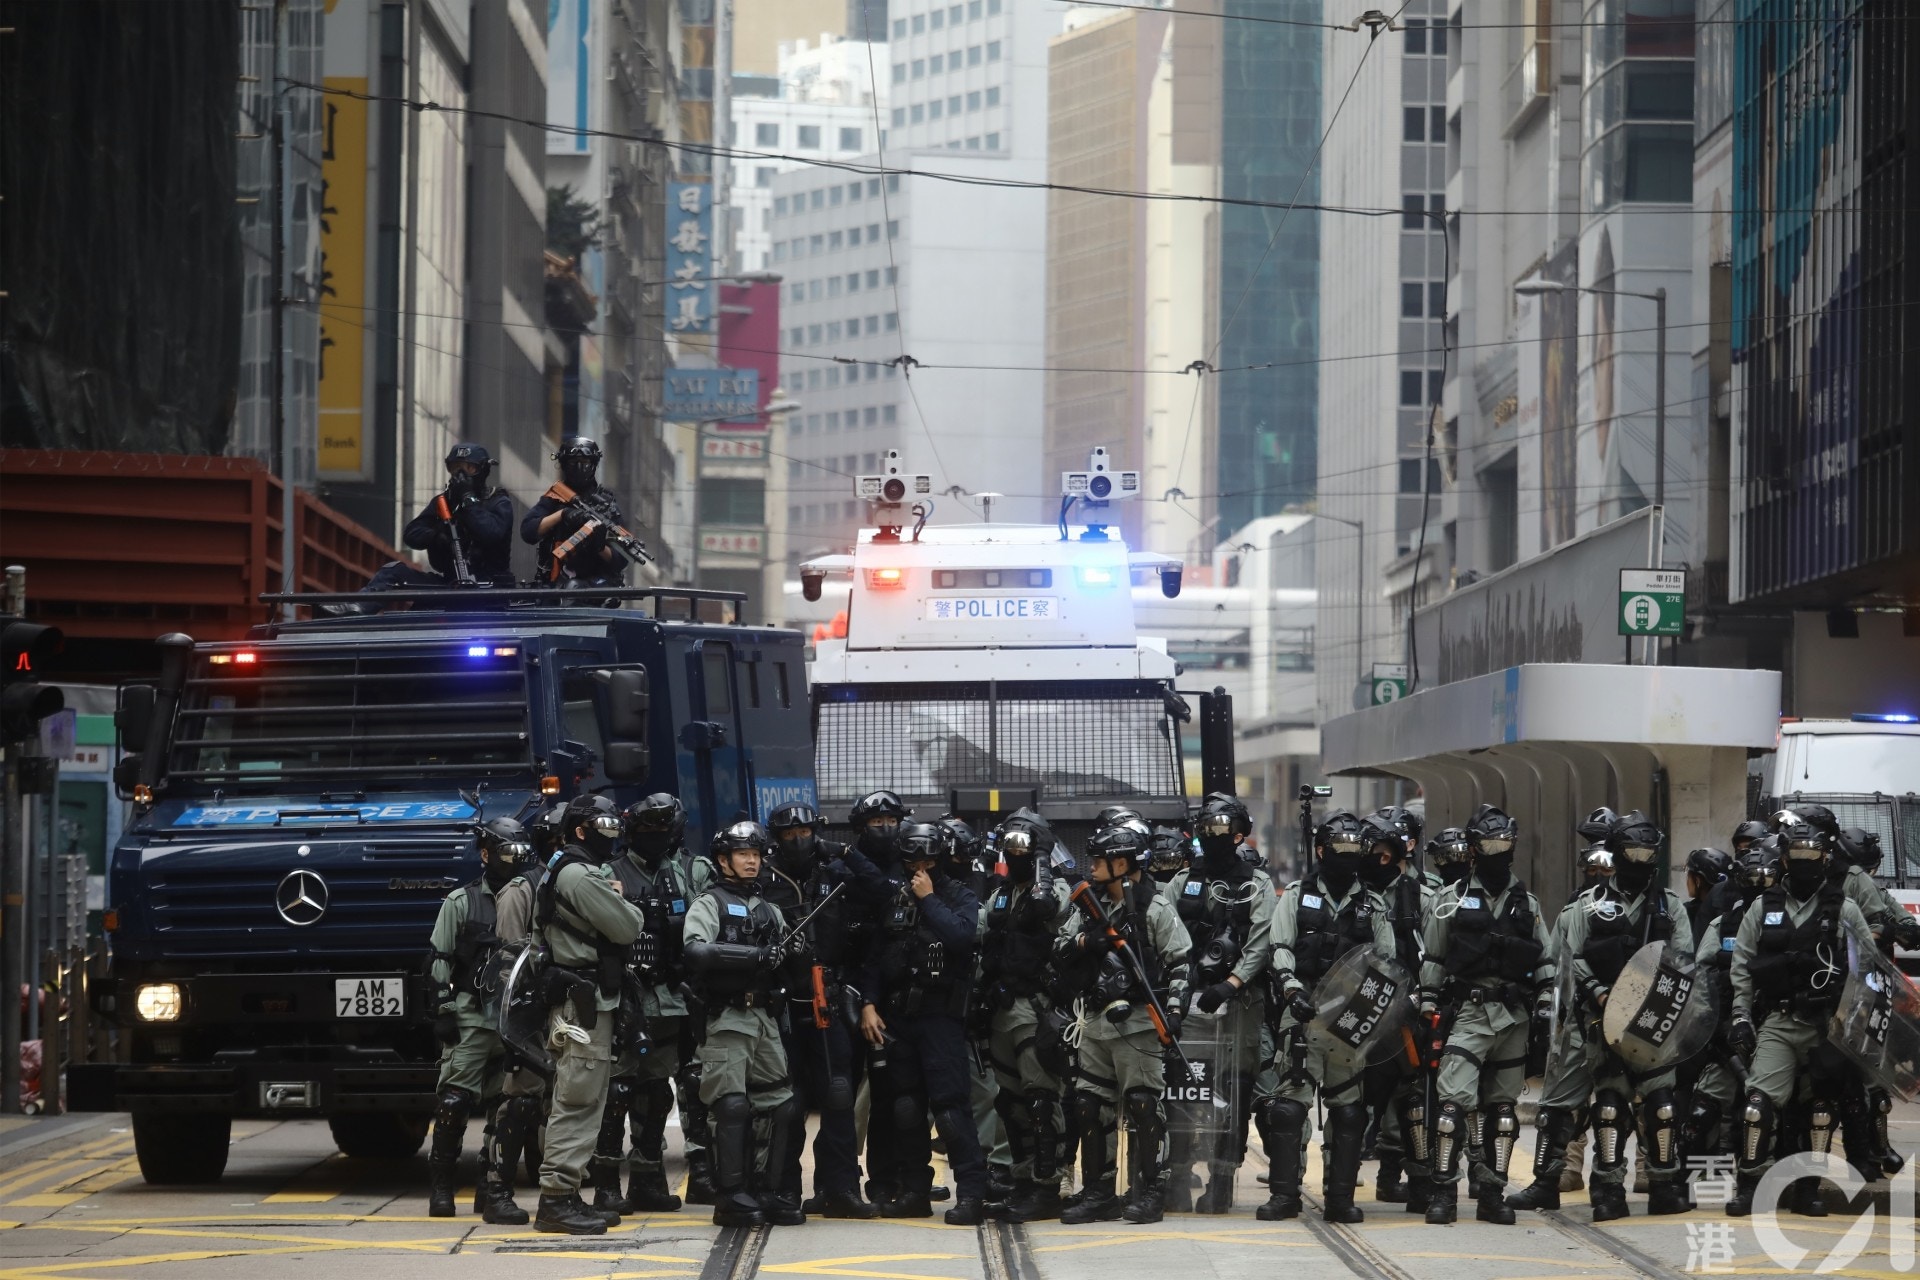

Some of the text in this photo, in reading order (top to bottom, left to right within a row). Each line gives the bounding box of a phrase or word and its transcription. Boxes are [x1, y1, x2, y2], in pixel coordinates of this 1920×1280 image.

[718, 377, 753, 396] FAT
[323, 438, 355, 449] Bank
[935, 599, 1049, 618] 警 POLICE 察
[339, 998, 401, 1016] 7882
[355, 980, 385, 998] AM
[1336, 976, 1380, 1031] 警察
[1636, 974, 1676, 1030] 警察
[1349, 982, 1395, 1045] POLICE
[1651, 978, 1692, 1043] POLICE
[1876, 974, 1893, 1043] POLICE
